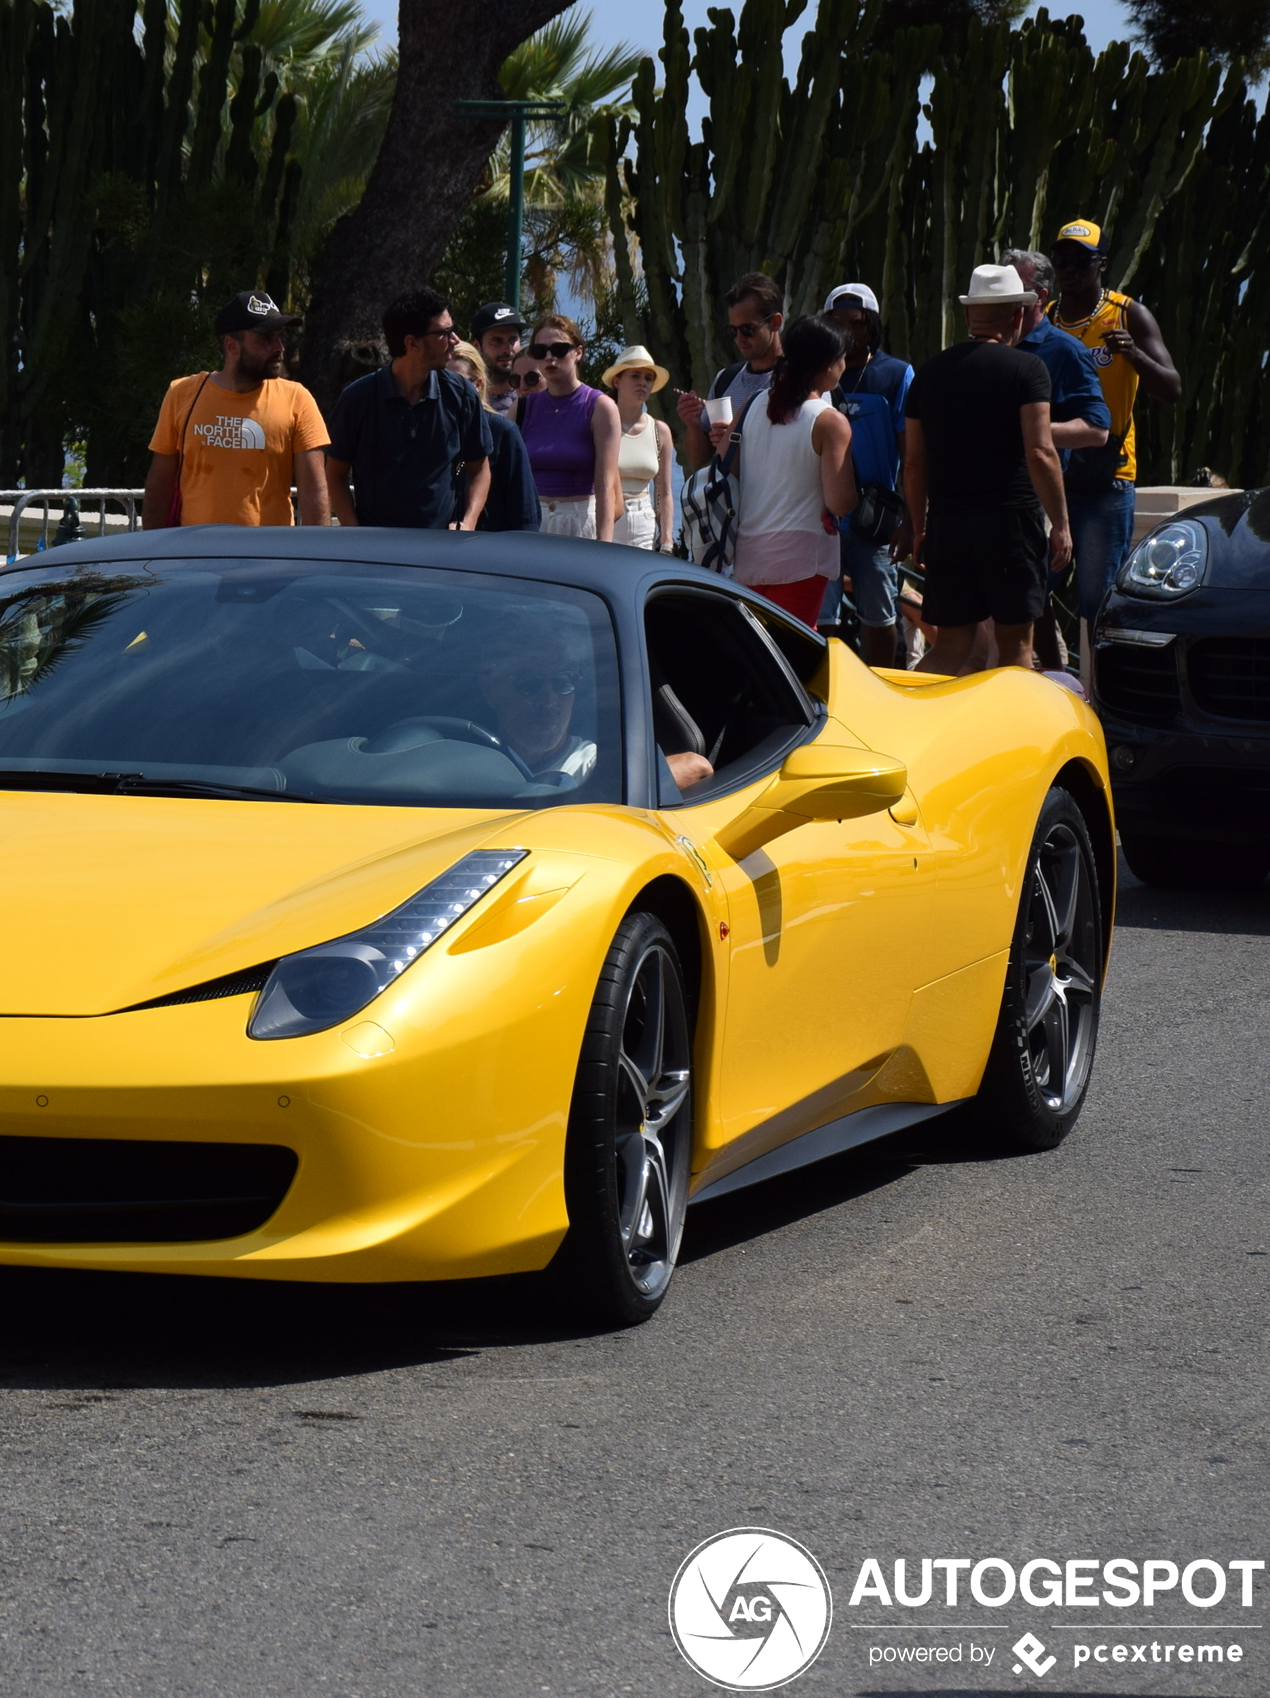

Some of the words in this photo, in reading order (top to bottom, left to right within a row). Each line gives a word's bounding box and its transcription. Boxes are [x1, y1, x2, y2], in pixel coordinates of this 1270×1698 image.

[215, 415, 242, 427] THE
[194, 424, 242, 438] NORTH
[206, 435, 242, 449] FACE
